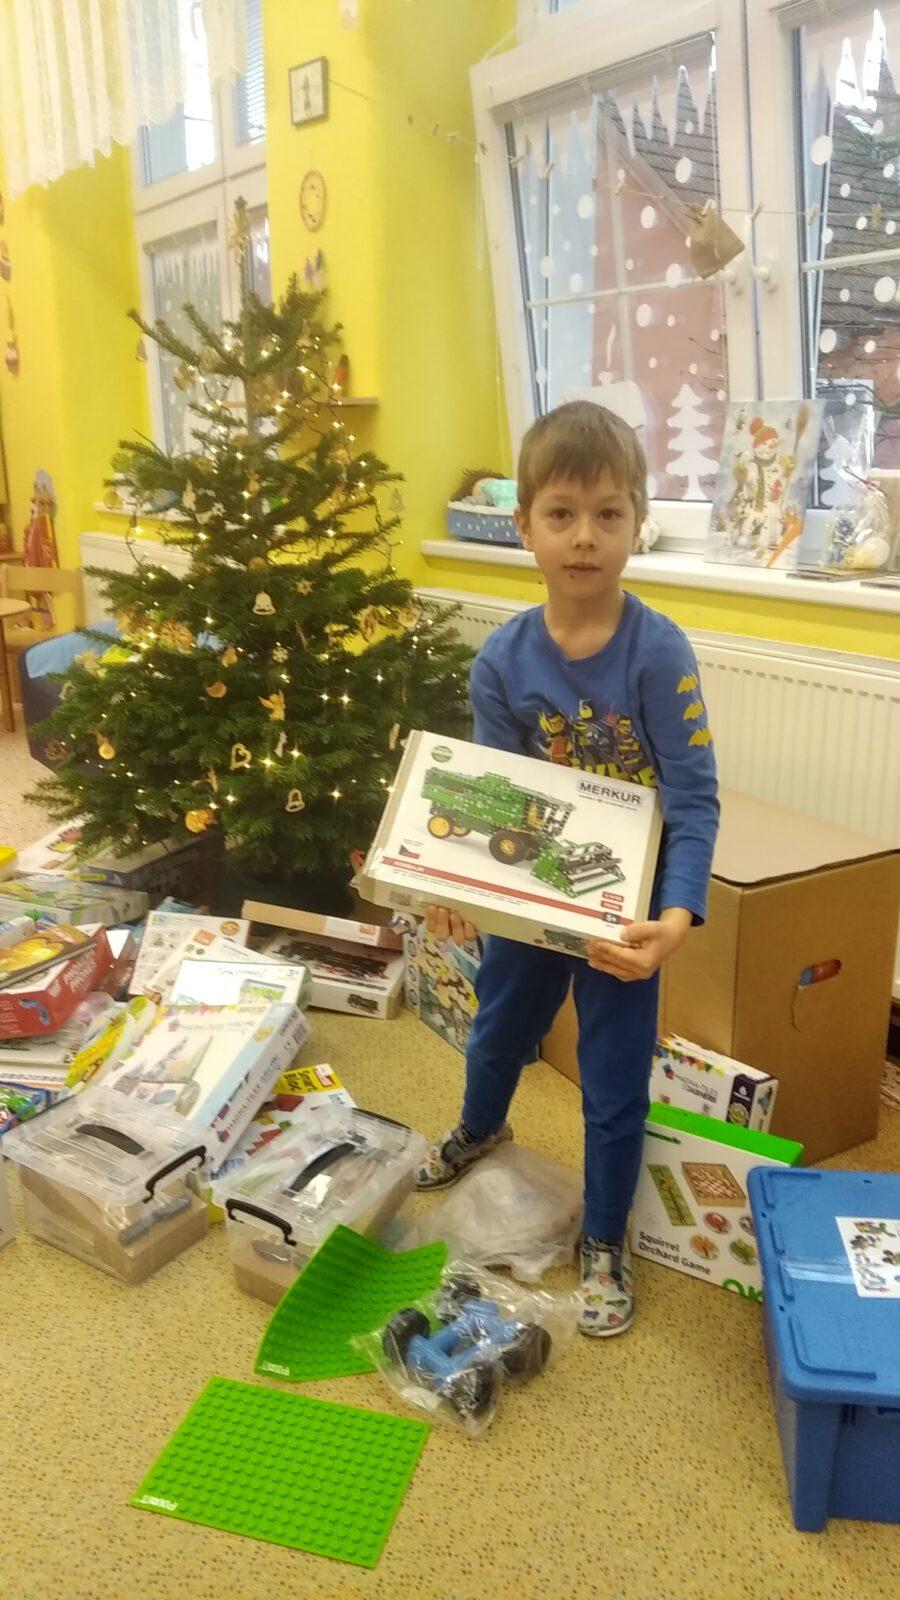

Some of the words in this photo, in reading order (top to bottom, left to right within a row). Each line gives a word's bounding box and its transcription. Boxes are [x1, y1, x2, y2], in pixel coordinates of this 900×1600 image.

[580, 782, 641, 805] MERKUR
[639, 1231, 680, 1253] Squirrel
[638, 1242, 680, 1264] Orchard
[681, 1256, 712, 1275] Game
